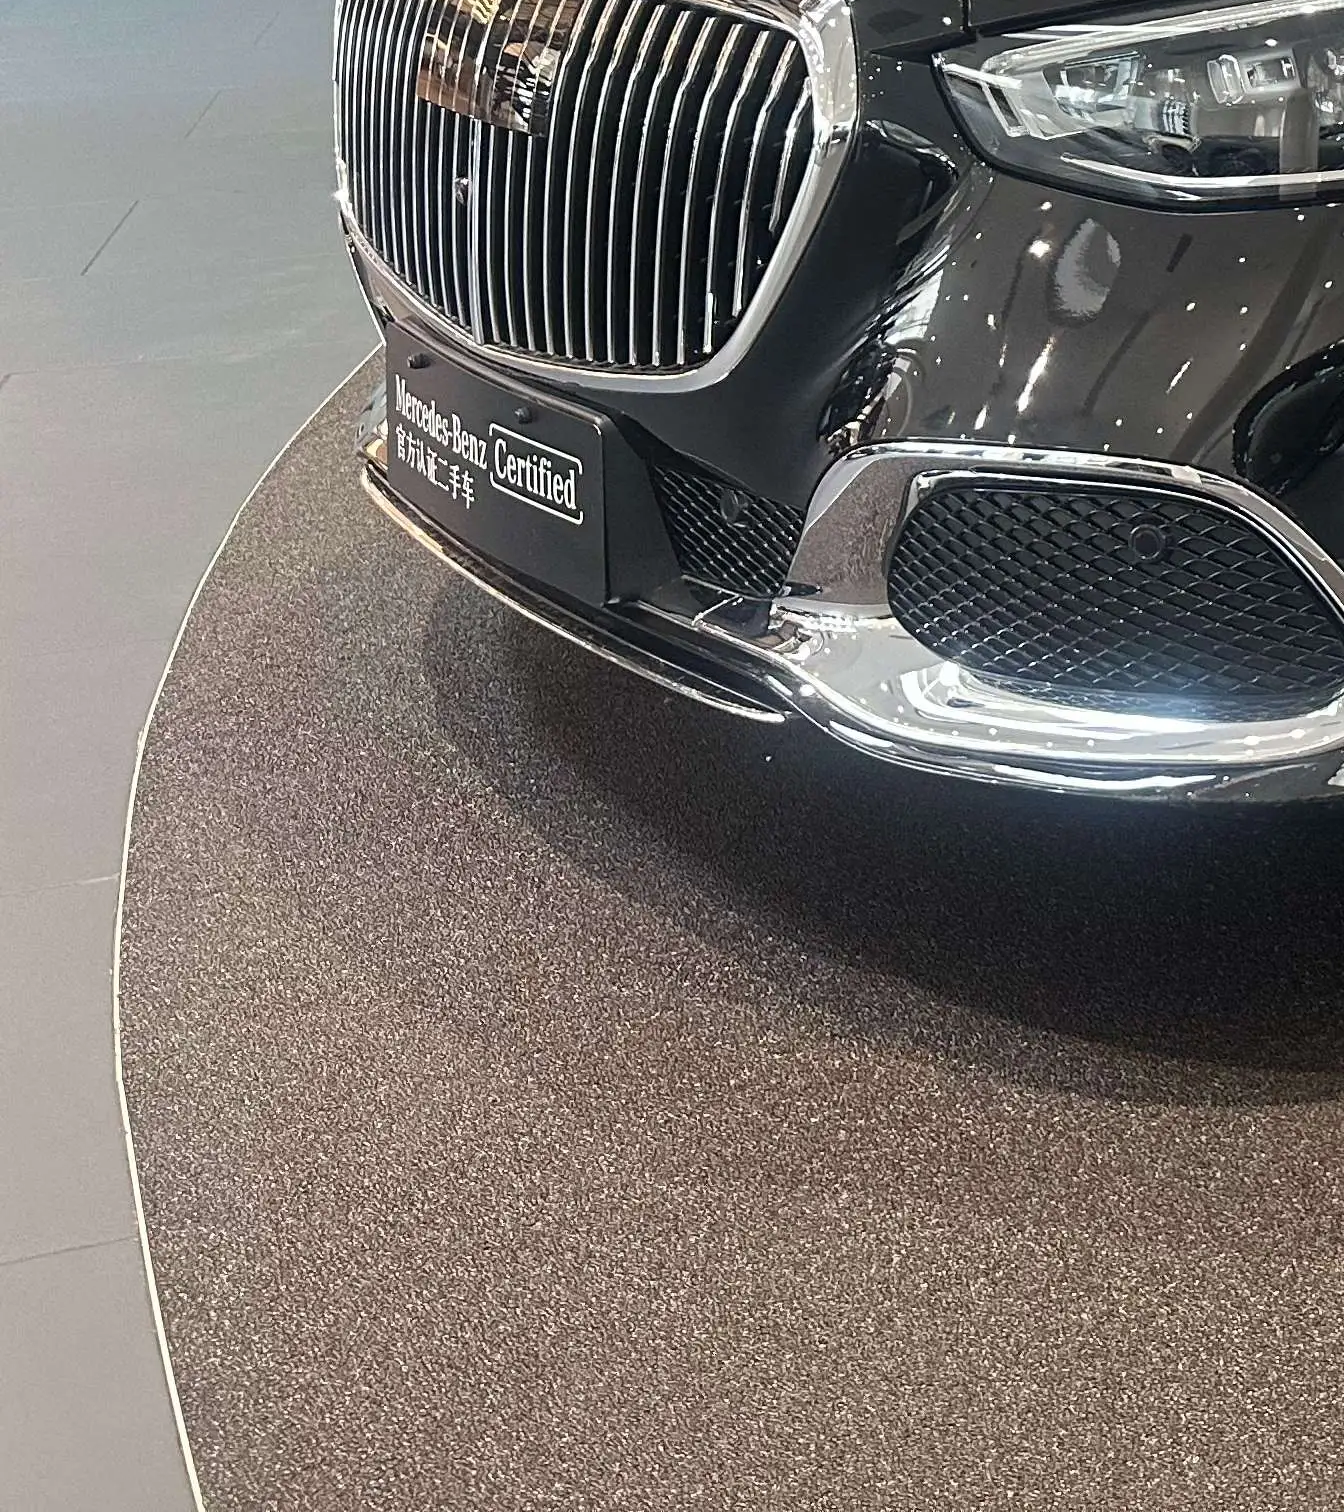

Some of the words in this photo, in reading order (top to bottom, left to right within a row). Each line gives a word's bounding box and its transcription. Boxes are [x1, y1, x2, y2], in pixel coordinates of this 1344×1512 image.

[395, 374, 487, 470] Mercedes-Benz
[494, 438, 577, 510] Certified
[396, 424, 475, 509] 官方认证二手车
